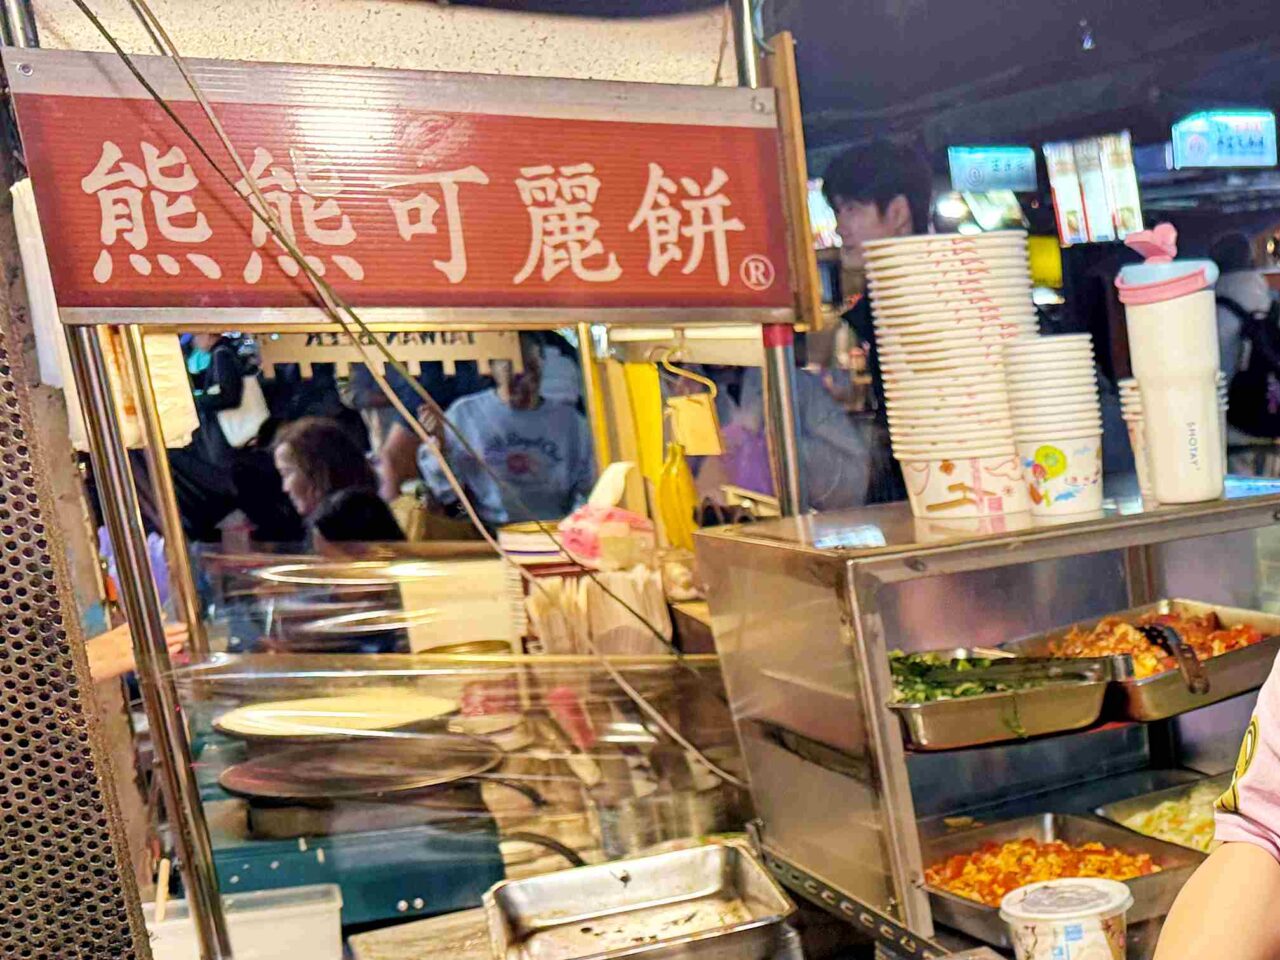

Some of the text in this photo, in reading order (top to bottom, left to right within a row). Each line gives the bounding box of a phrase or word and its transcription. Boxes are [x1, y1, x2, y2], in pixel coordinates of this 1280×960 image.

[81, 138, 746, 287] 熊熊可麗餅
